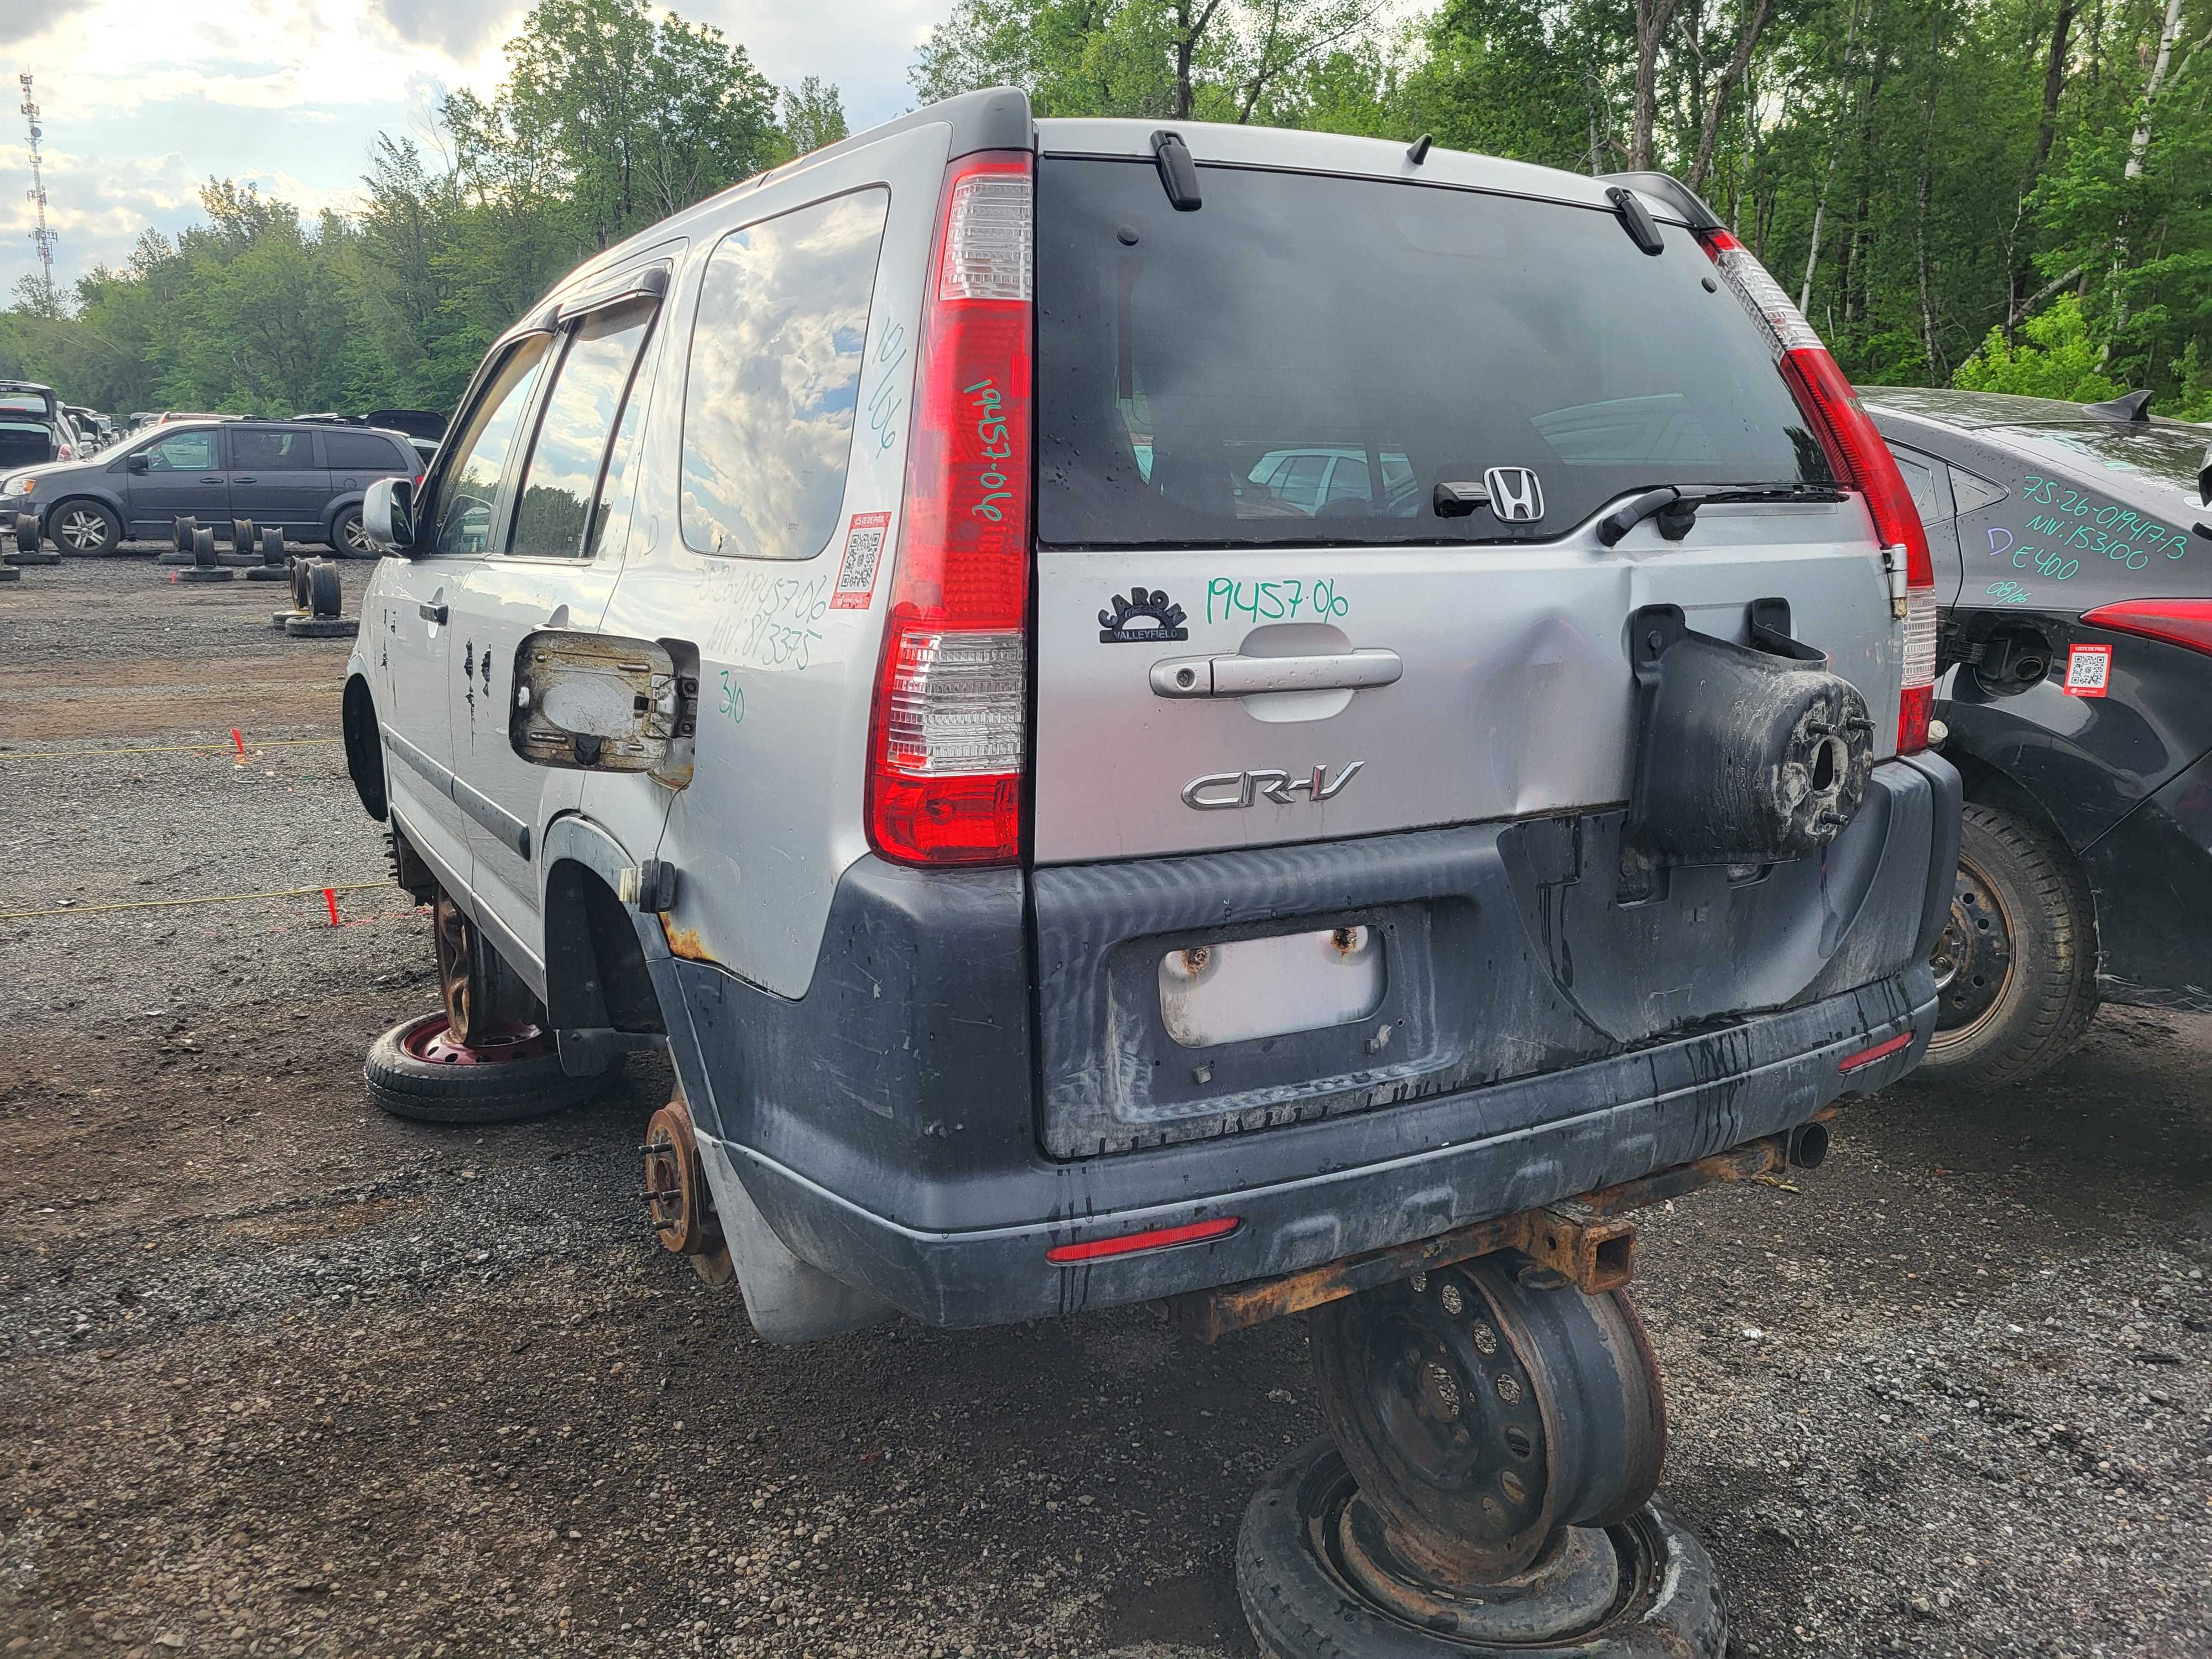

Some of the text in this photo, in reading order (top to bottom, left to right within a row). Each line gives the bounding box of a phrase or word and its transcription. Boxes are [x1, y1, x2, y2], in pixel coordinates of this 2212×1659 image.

[1987, 528, 2014, 555] D
[1098, 587, 1188, 628] CARON
[1113, 629, 1178, 640] VALLEYFIELD
[1181, 760, 1367, 811] CR-V
